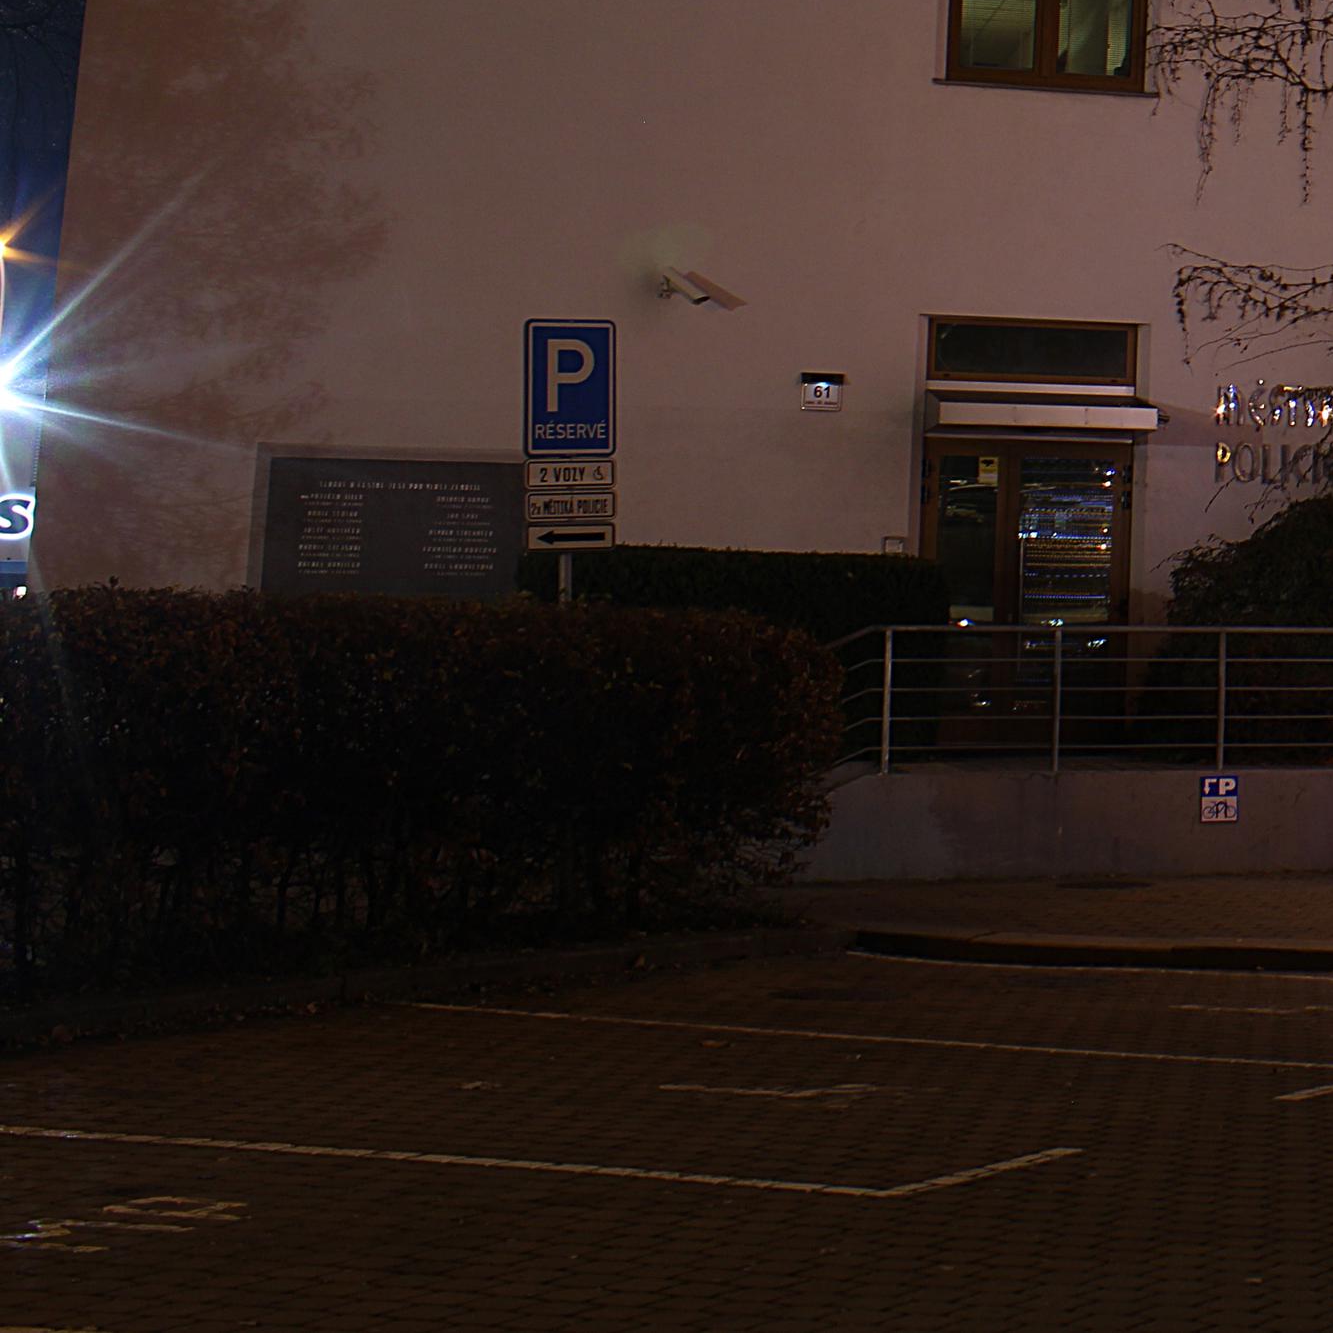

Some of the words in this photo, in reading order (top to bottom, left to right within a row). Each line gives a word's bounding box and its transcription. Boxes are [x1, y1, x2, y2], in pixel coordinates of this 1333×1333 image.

[546, 338, 595, 413] P
[814, 385, 830, 399] 61
[535, 420, 607, 441] RÉSERVÉ
[540, 468, 548, 483] 2
[554, 467, 586, 483] VOZY
[577, 498, 608, 515] POLICIE
[1218, 778, 1236, 795] P
